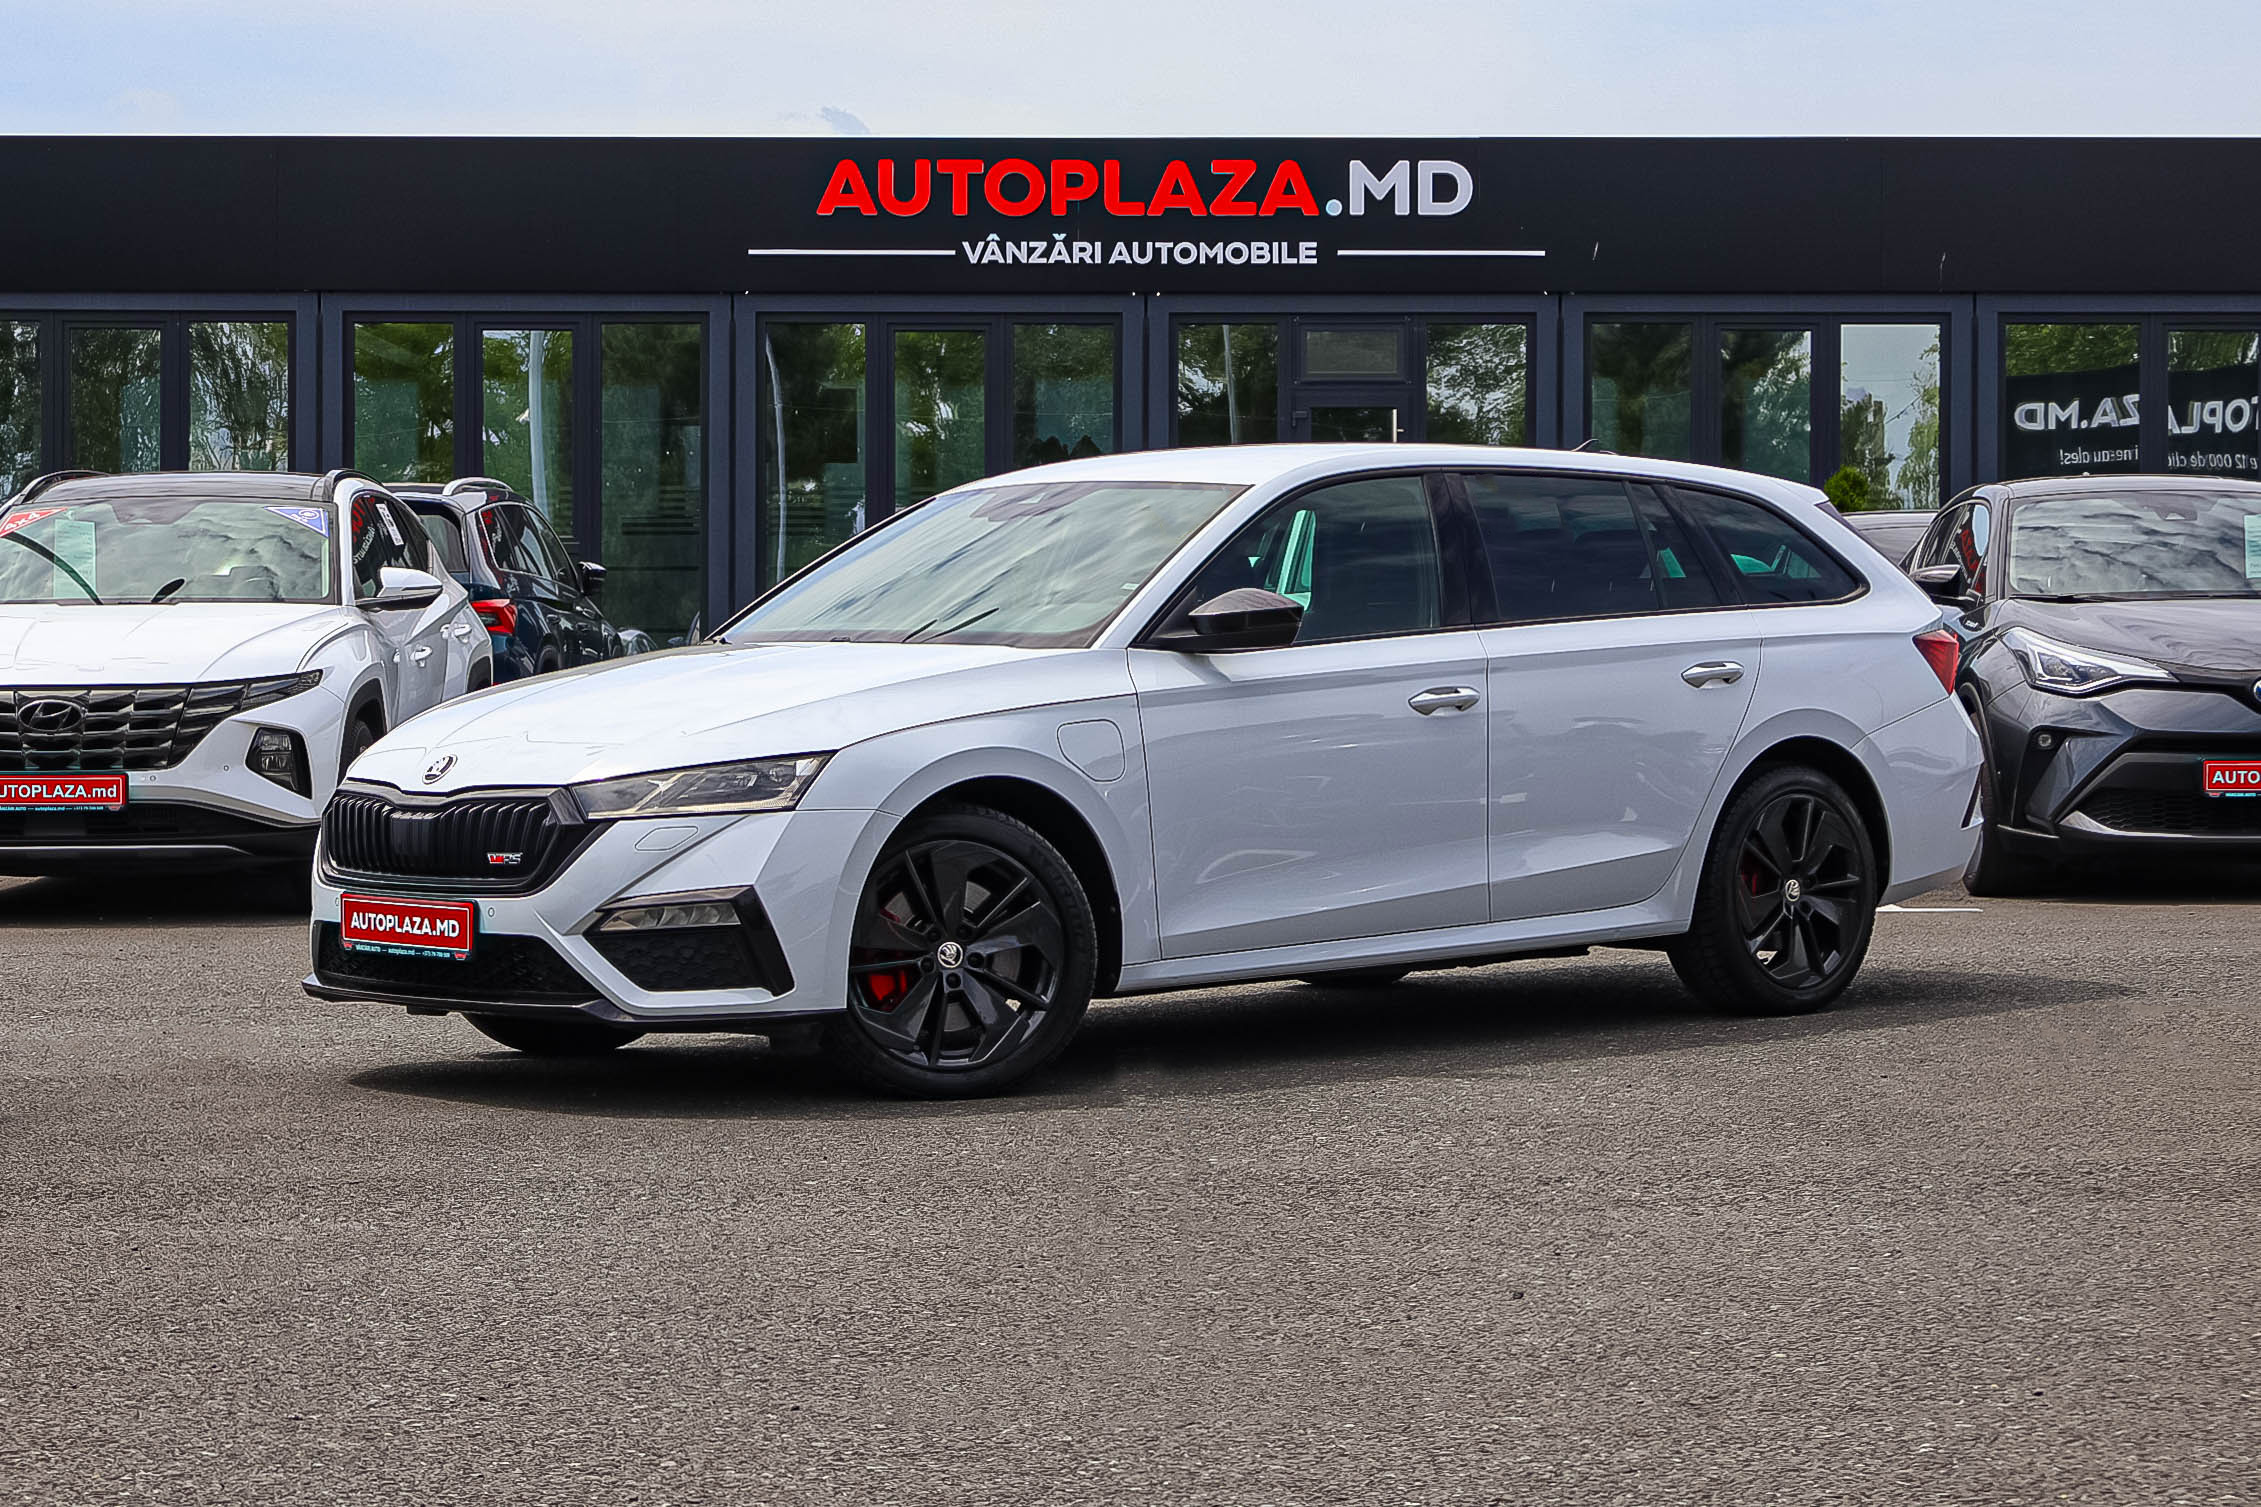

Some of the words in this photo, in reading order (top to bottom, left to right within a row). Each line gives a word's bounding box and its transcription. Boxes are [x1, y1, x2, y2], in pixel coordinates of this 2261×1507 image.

[816, 158, 1474, 218] AUTOPLAZA.MD
[962, 234, 1102, 266] VÂNZĂRI
[1110, 241, 1319, 266] AUTOMOBILE
[351, 911, 460, 938] AUTOPLAZA.MD
